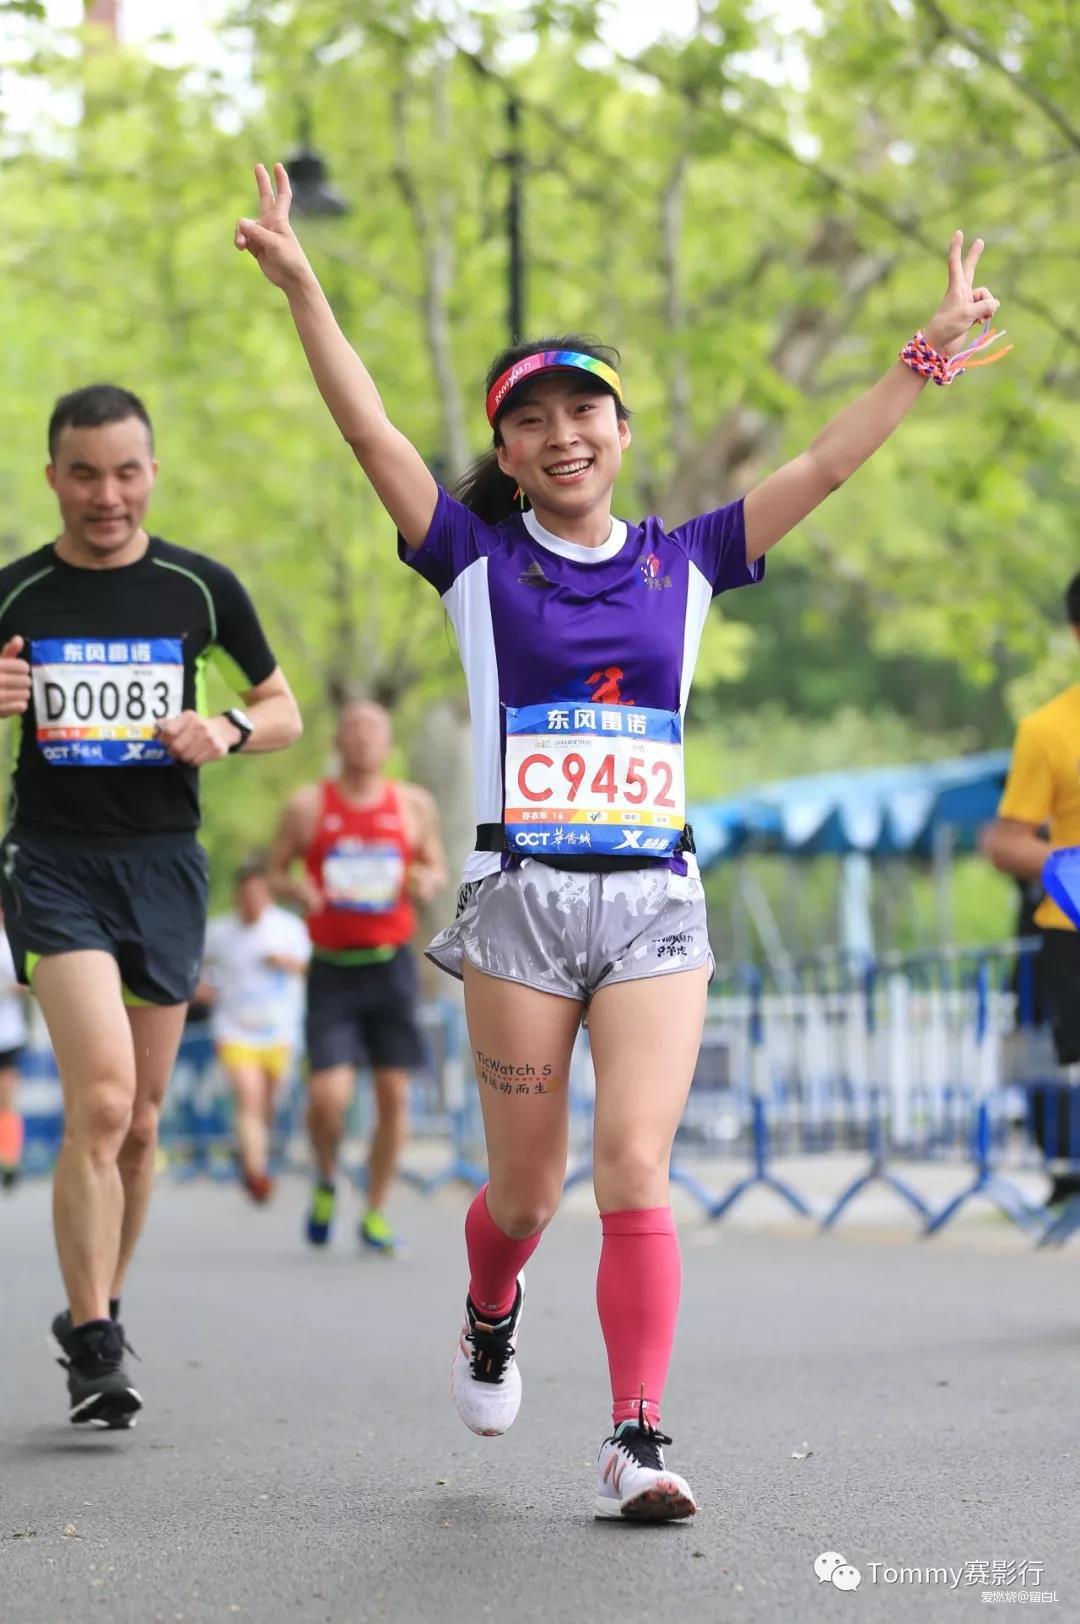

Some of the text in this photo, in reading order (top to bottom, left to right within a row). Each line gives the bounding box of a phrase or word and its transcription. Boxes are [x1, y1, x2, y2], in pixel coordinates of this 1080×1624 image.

[44, 681, 170, 721] D0083
[547, 708, 648, 735] 东风雷诺
[517, 752, 676, 809] C9452
[515, 832, 550, 846] OCT
[476, 1051, 552, 1076] TicWatch S
